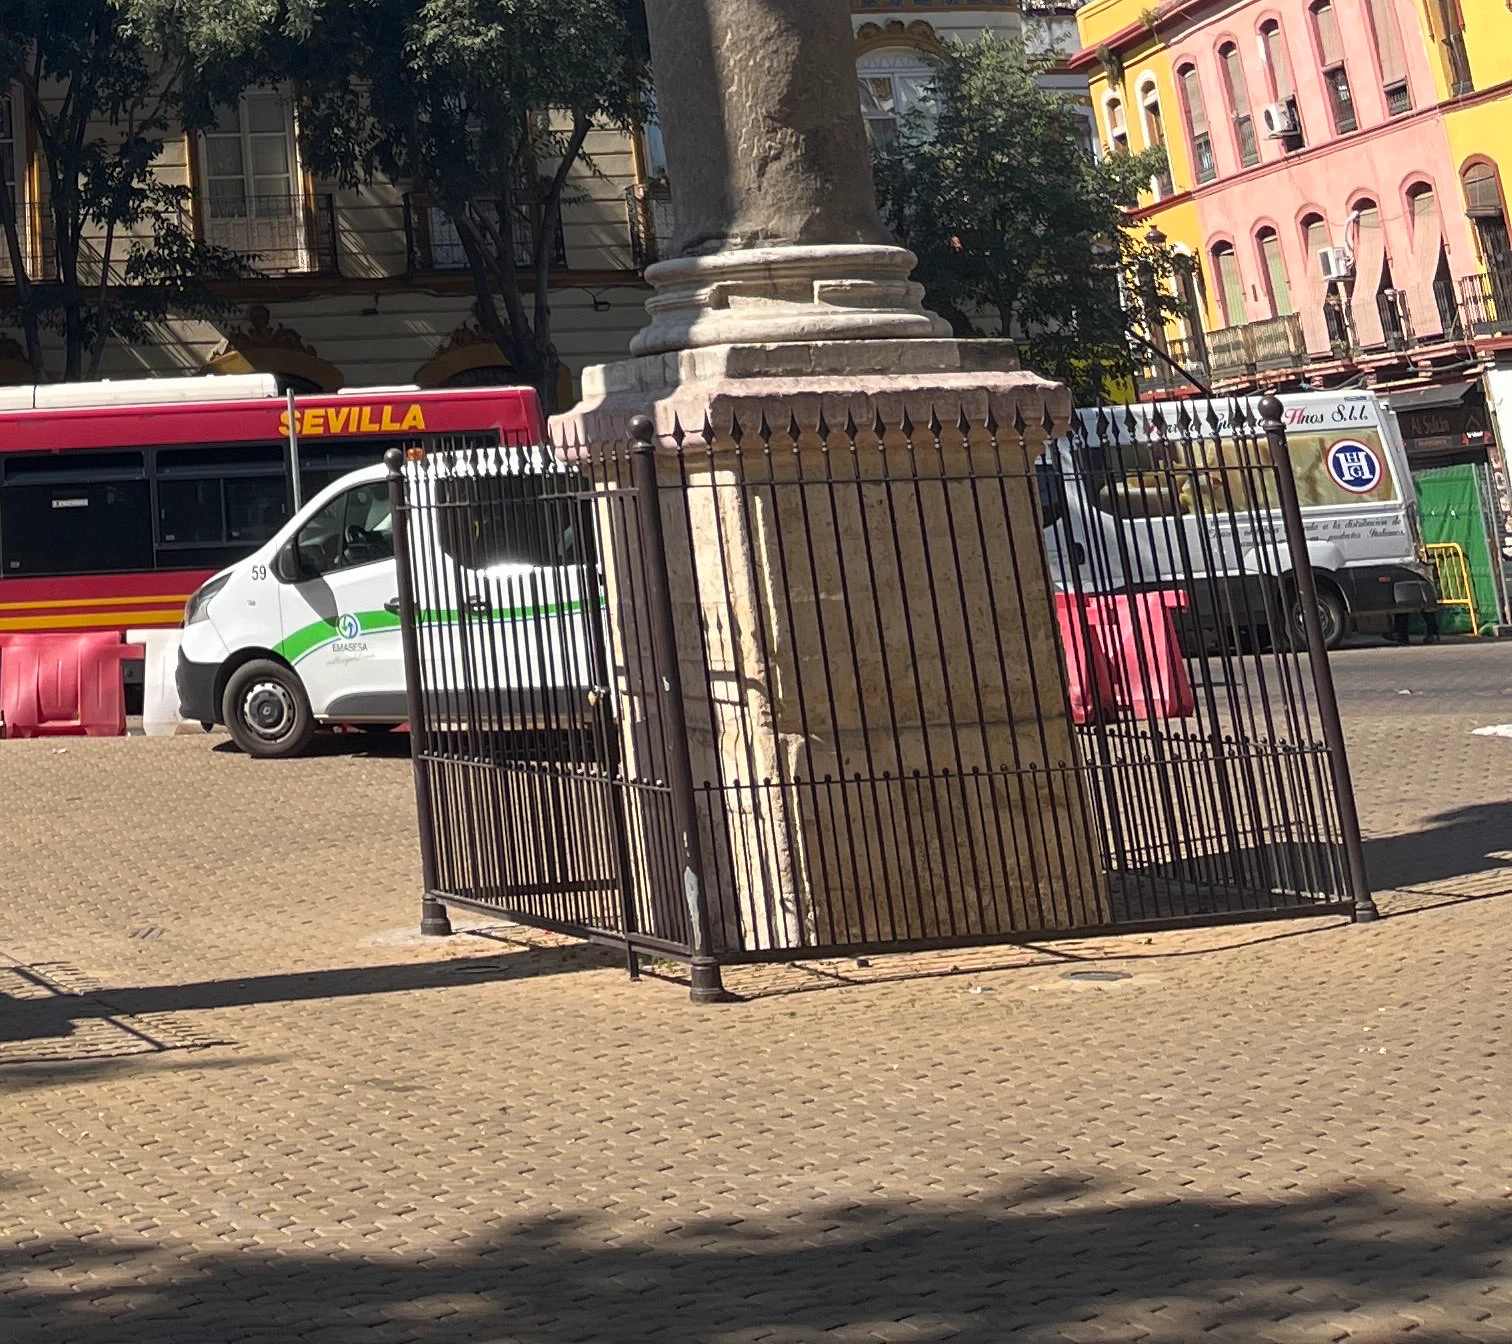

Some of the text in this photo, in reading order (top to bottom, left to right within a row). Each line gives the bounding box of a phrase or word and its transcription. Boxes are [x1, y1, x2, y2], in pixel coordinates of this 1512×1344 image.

[278, 403, 426, 436] SEVILLA
[1284, 407, 1324, 425] Hnos
[251, 565, 267, 581] 59
[332, 642, 368, 652] EMASESA
